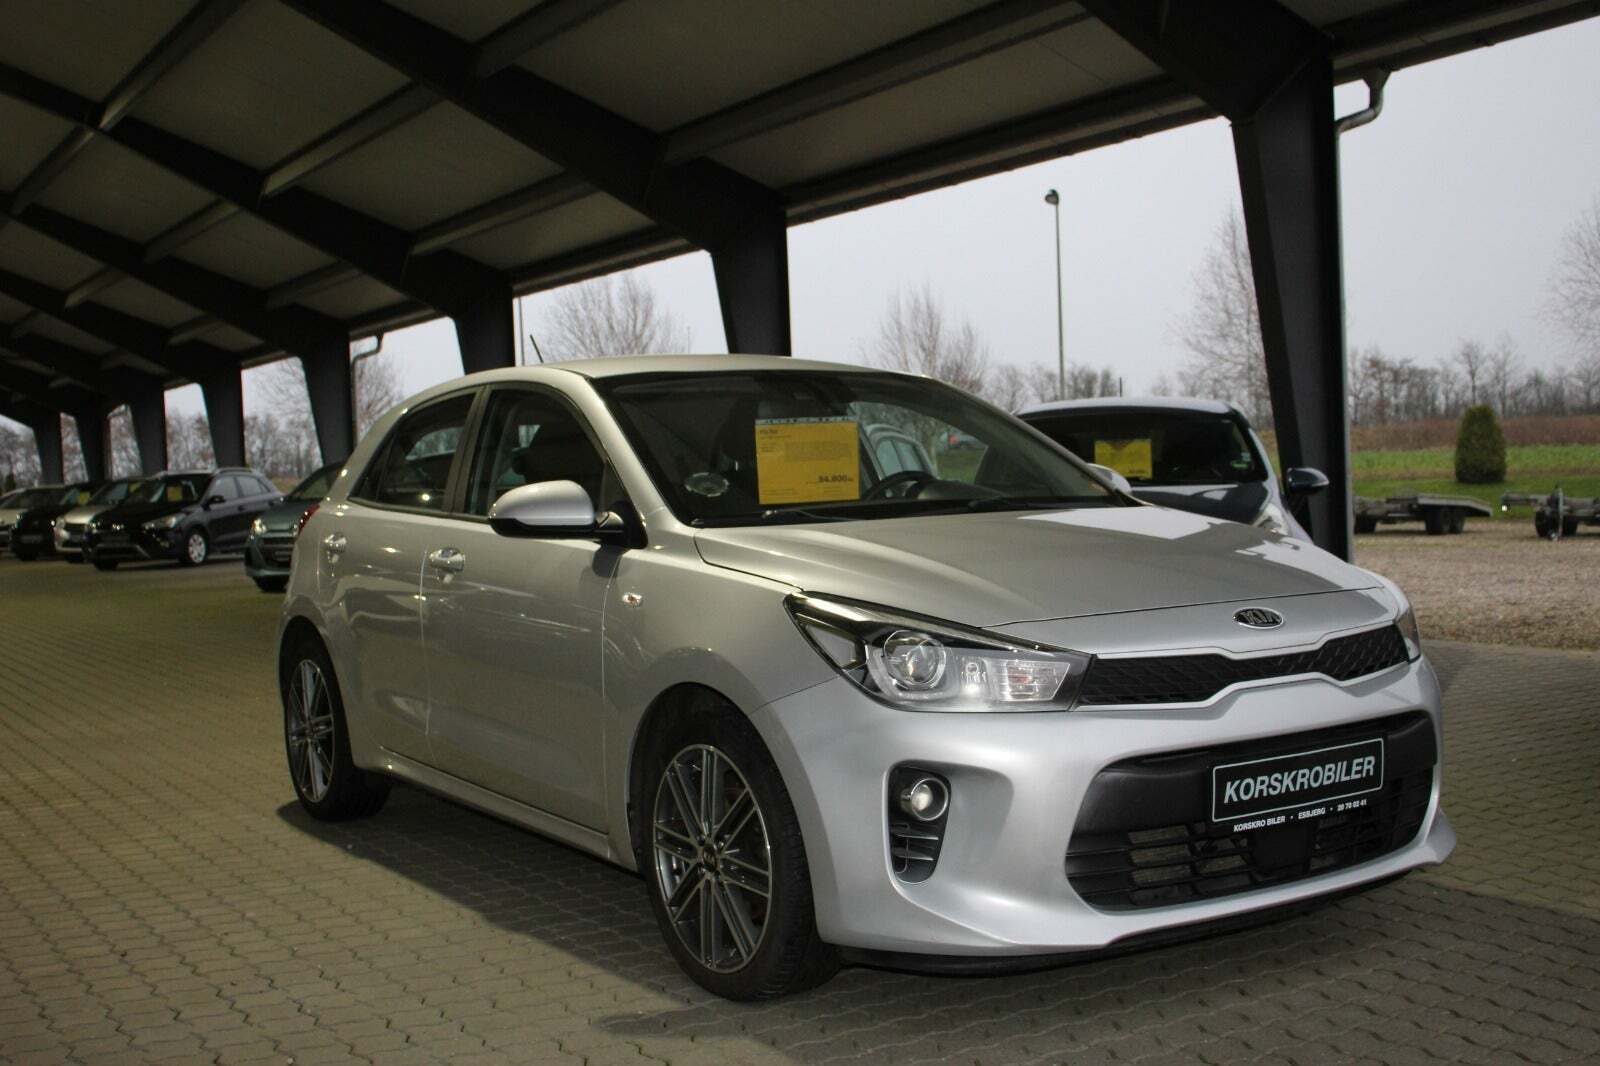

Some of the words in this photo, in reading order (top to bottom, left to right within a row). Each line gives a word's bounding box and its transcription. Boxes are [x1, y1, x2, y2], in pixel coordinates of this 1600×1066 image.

[1236, 609, 1281, 625] KIA
[1223, 755, 1376, 804] KORSKROBILER
[1233, 819, 1266, 833] KORSKRO
[1266, 815, 1286, 826] BILER
